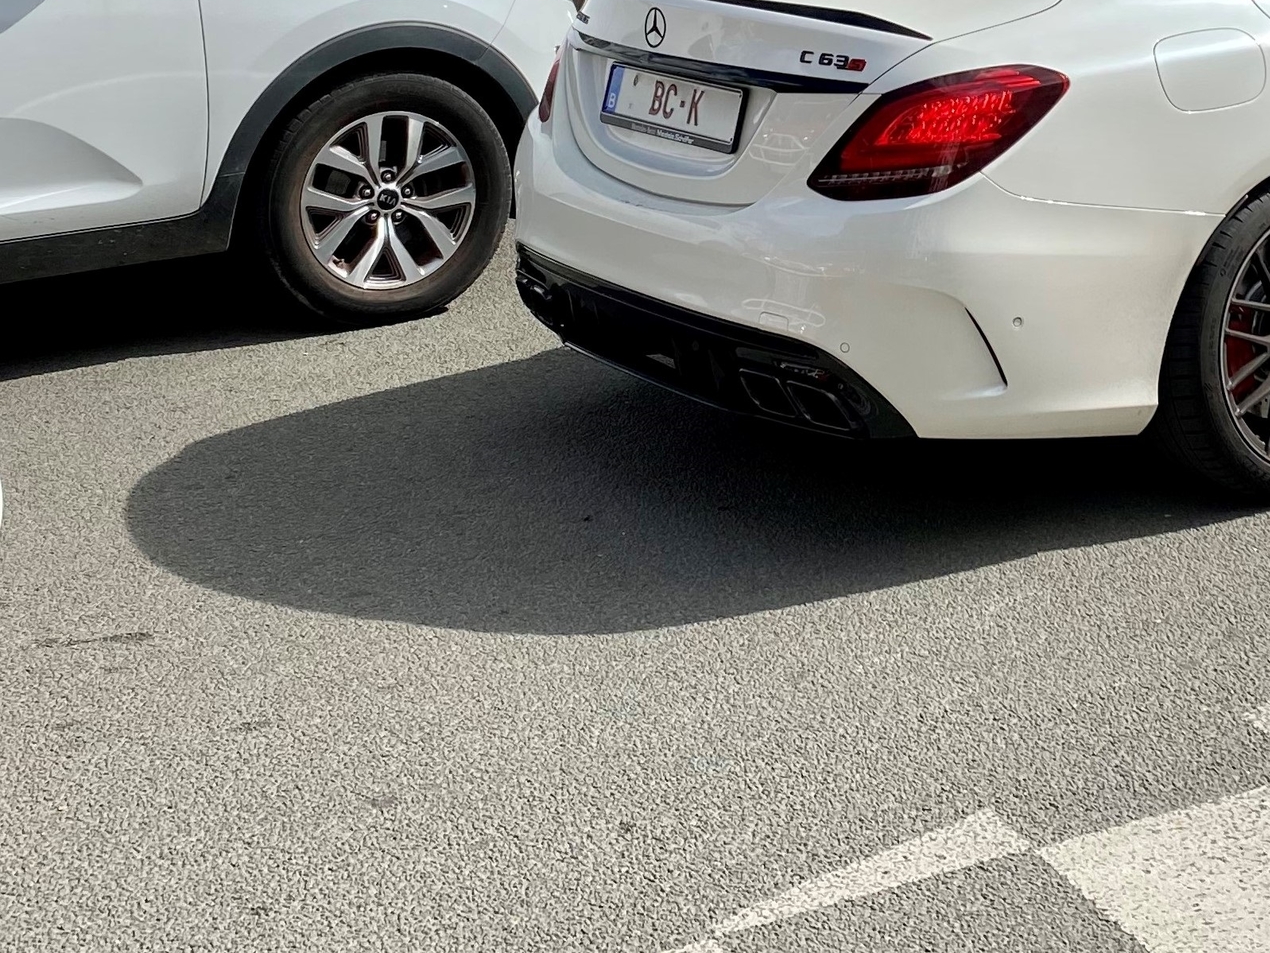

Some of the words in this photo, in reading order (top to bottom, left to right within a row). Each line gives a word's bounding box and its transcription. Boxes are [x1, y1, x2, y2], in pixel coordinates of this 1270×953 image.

[799, 50, 815, 64] C
[607, 92, 616, 109] B
[379, 193, 397, 207] KIA
